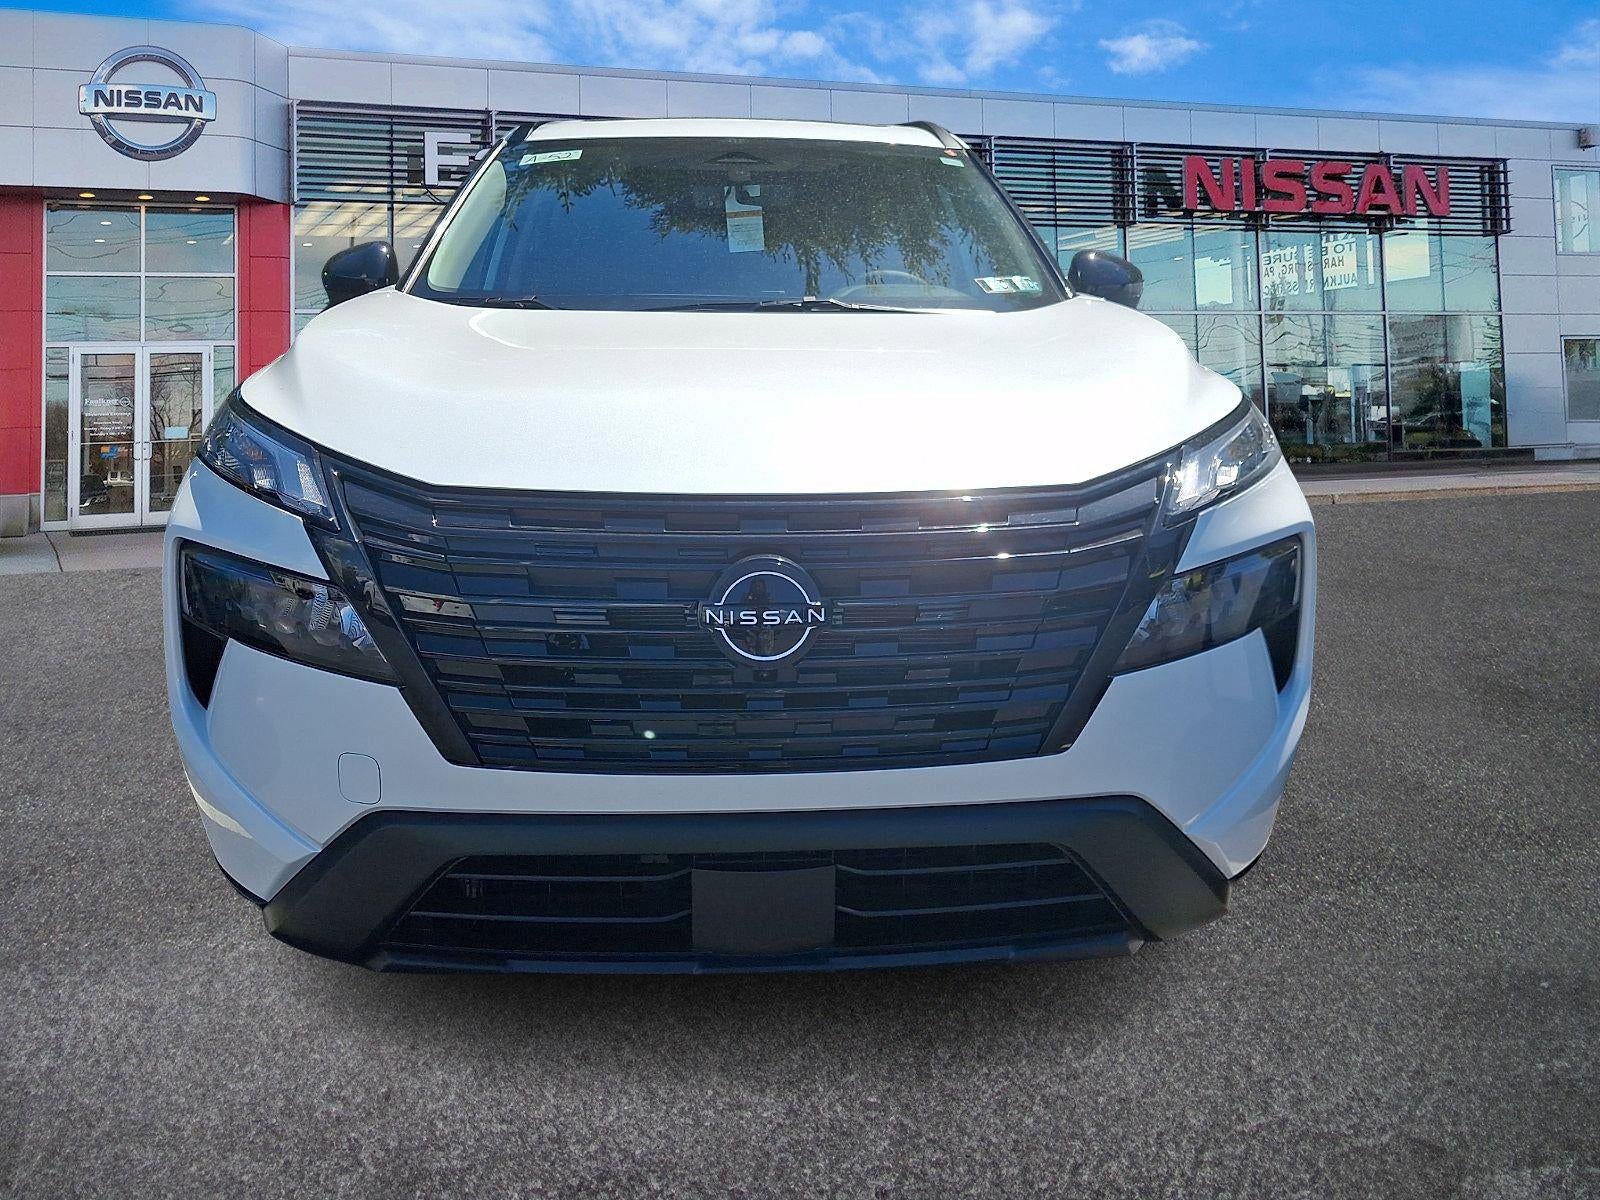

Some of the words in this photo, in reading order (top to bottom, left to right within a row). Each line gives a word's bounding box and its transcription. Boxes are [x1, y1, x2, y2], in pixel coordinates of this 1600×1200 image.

[94, 89, 203, 113] NISSAN
[424, 131, 490, 186] F
[1182, 155, 1451, 216] NISSAN
[705, 607, 825, 625] NISSAN
